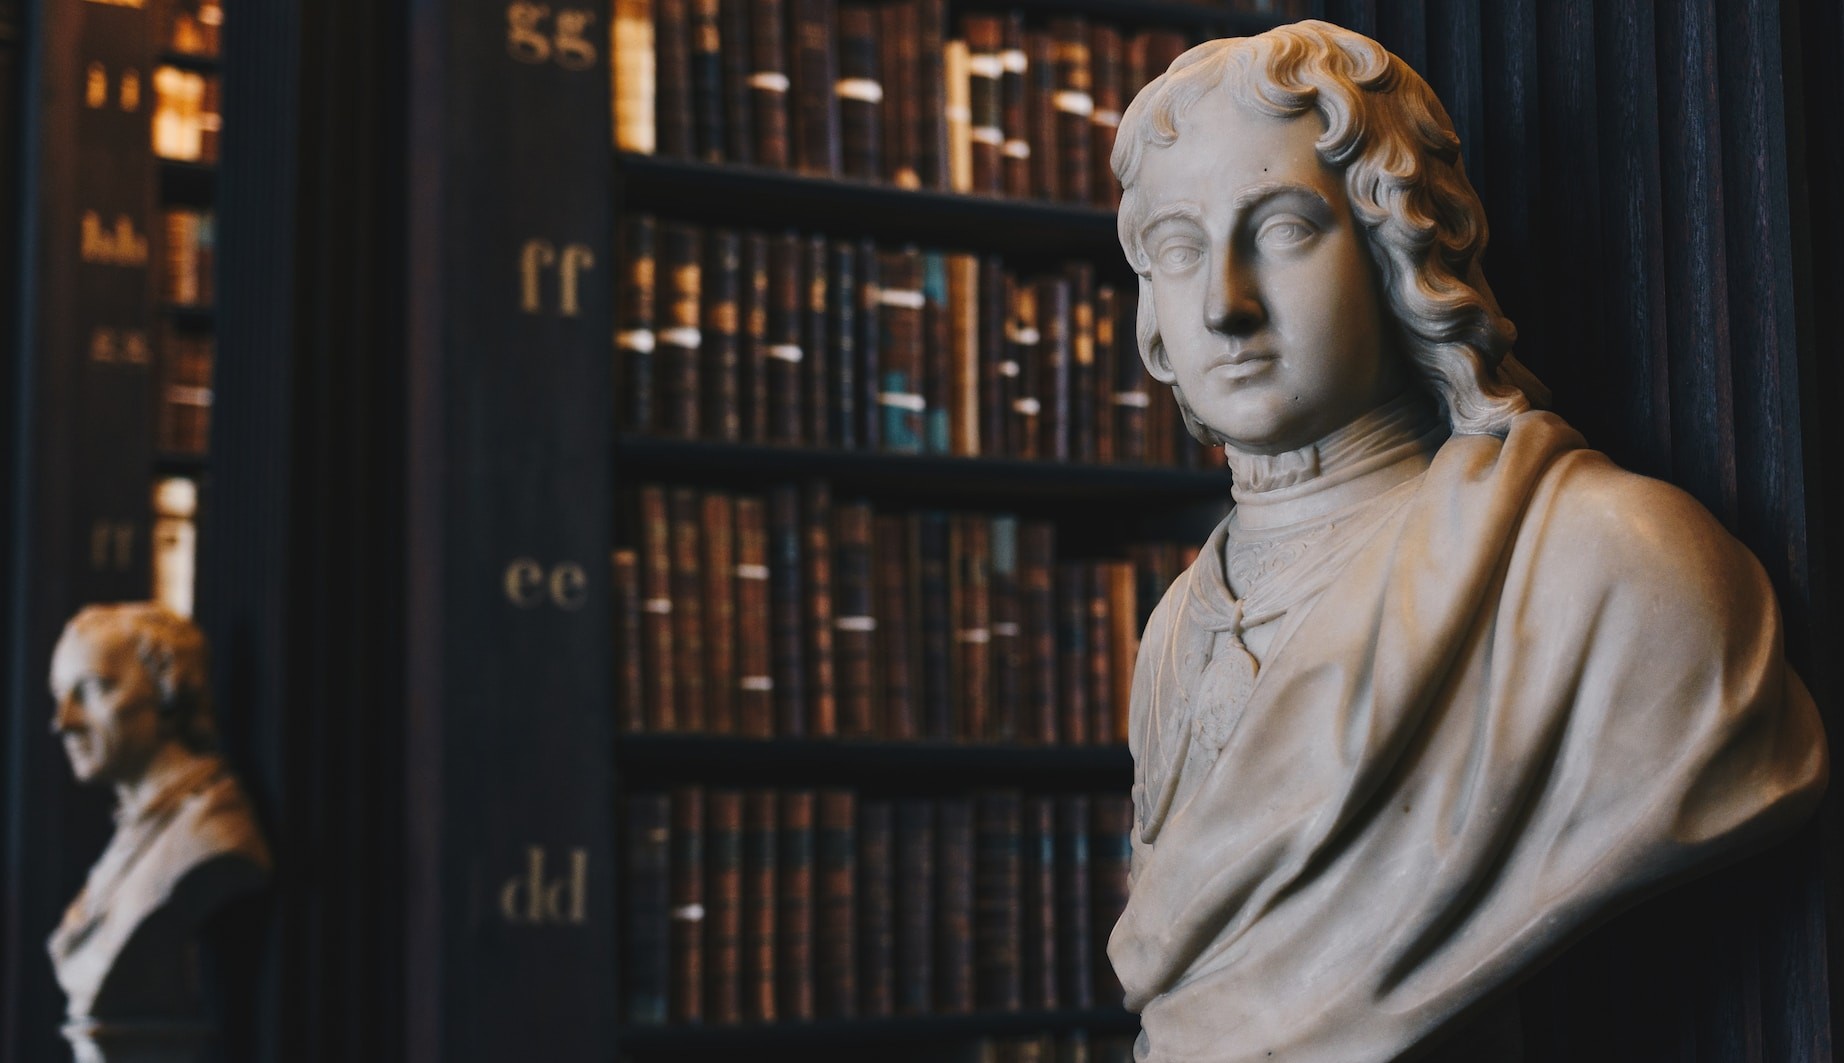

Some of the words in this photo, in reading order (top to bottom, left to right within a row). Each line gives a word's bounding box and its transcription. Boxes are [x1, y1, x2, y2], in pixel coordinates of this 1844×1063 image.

[506, 0, 597, 70] gg
[519, 238, 595, 317] ff
[503, 556, 588, 611] ee
[501, 844, 587, 925] dd
